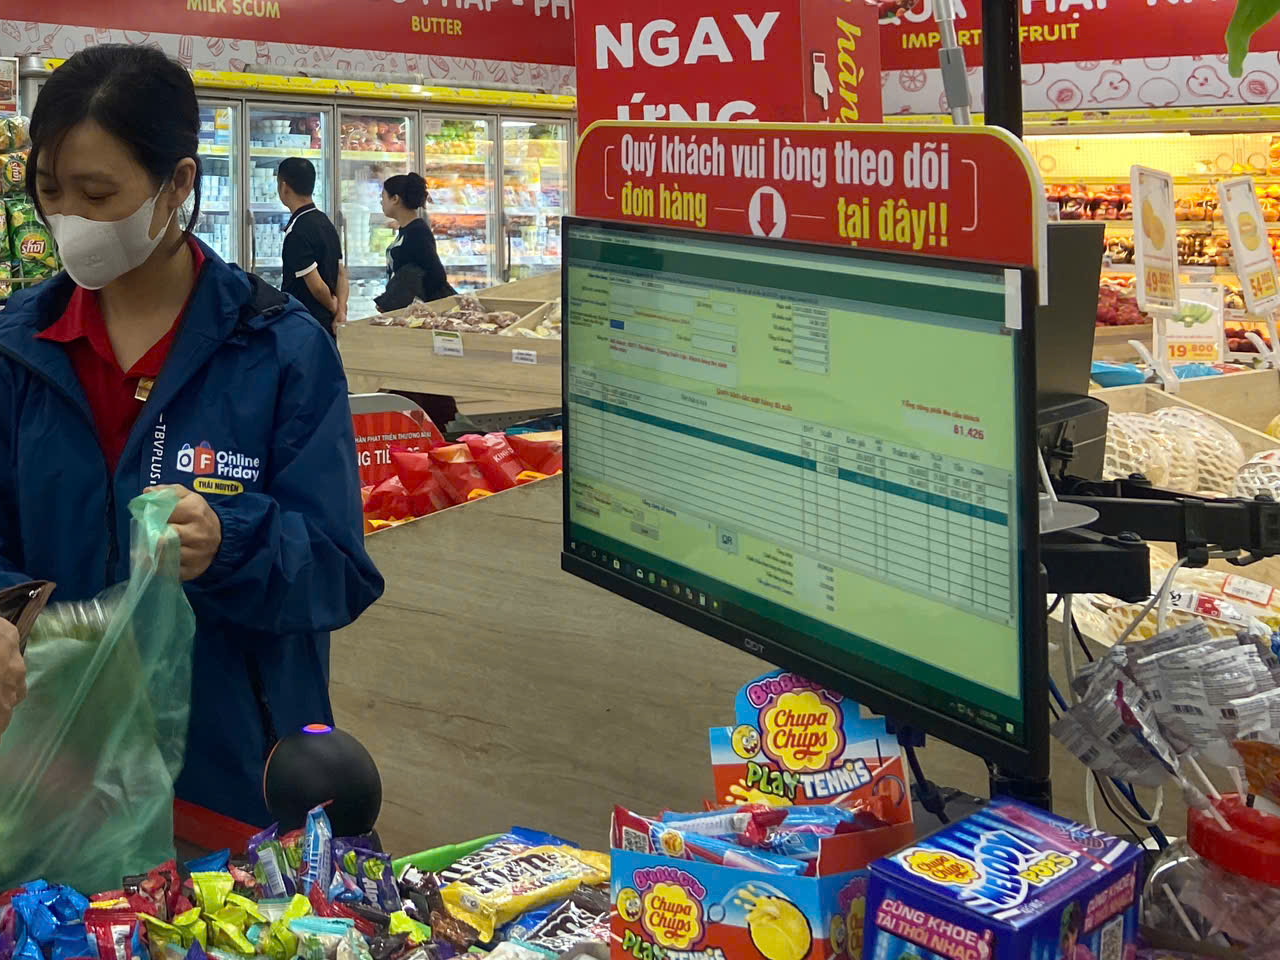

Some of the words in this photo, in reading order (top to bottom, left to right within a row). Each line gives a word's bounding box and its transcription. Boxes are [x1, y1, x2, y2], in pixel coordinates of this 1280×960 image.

[411, 14, 464, 37] BUTTER
[902, 29, 982, 50] IMPRT
[1019, 22, 1080, 43] FRUIT
[594, 11, 782, 71] NGAY
[836, 16, 865, 124] hàn
[620, 133, 657, 189] Quý
[661, 133, 725, 178] khách
[732, 142, 766, 181] vui
[773, 138, 827, 188] lòng
[834, 140, 894, 188] theo
[903, 141, 950, 191] dõi
[621, 180, 655, 218] đơn
[659, 183, 708, 228] hàng
[837, 196, 871, 248] tại
[877, 196, 949, 250] đây!!
[200, 453, 212, 470] F
[215, 450, 261, 469] Online
[217, 463, 261, 483] Friday
[198, 480, 214, 490] THÁI
[214, 481, 240, 493] NGUYÊN
[774, 709, 828, 732] Chupa
[773, 729, 828, 759] Chups
[746, 761, 801, 799] PLAY
[800, 758, 873, 798] TENNIS
[1018, 852, 1075, 884] POPS
[650, 895, 692, 920] Chupa
[880, 899, 925, 924] CÙNG
[649, 912, 692, 939] Chups
